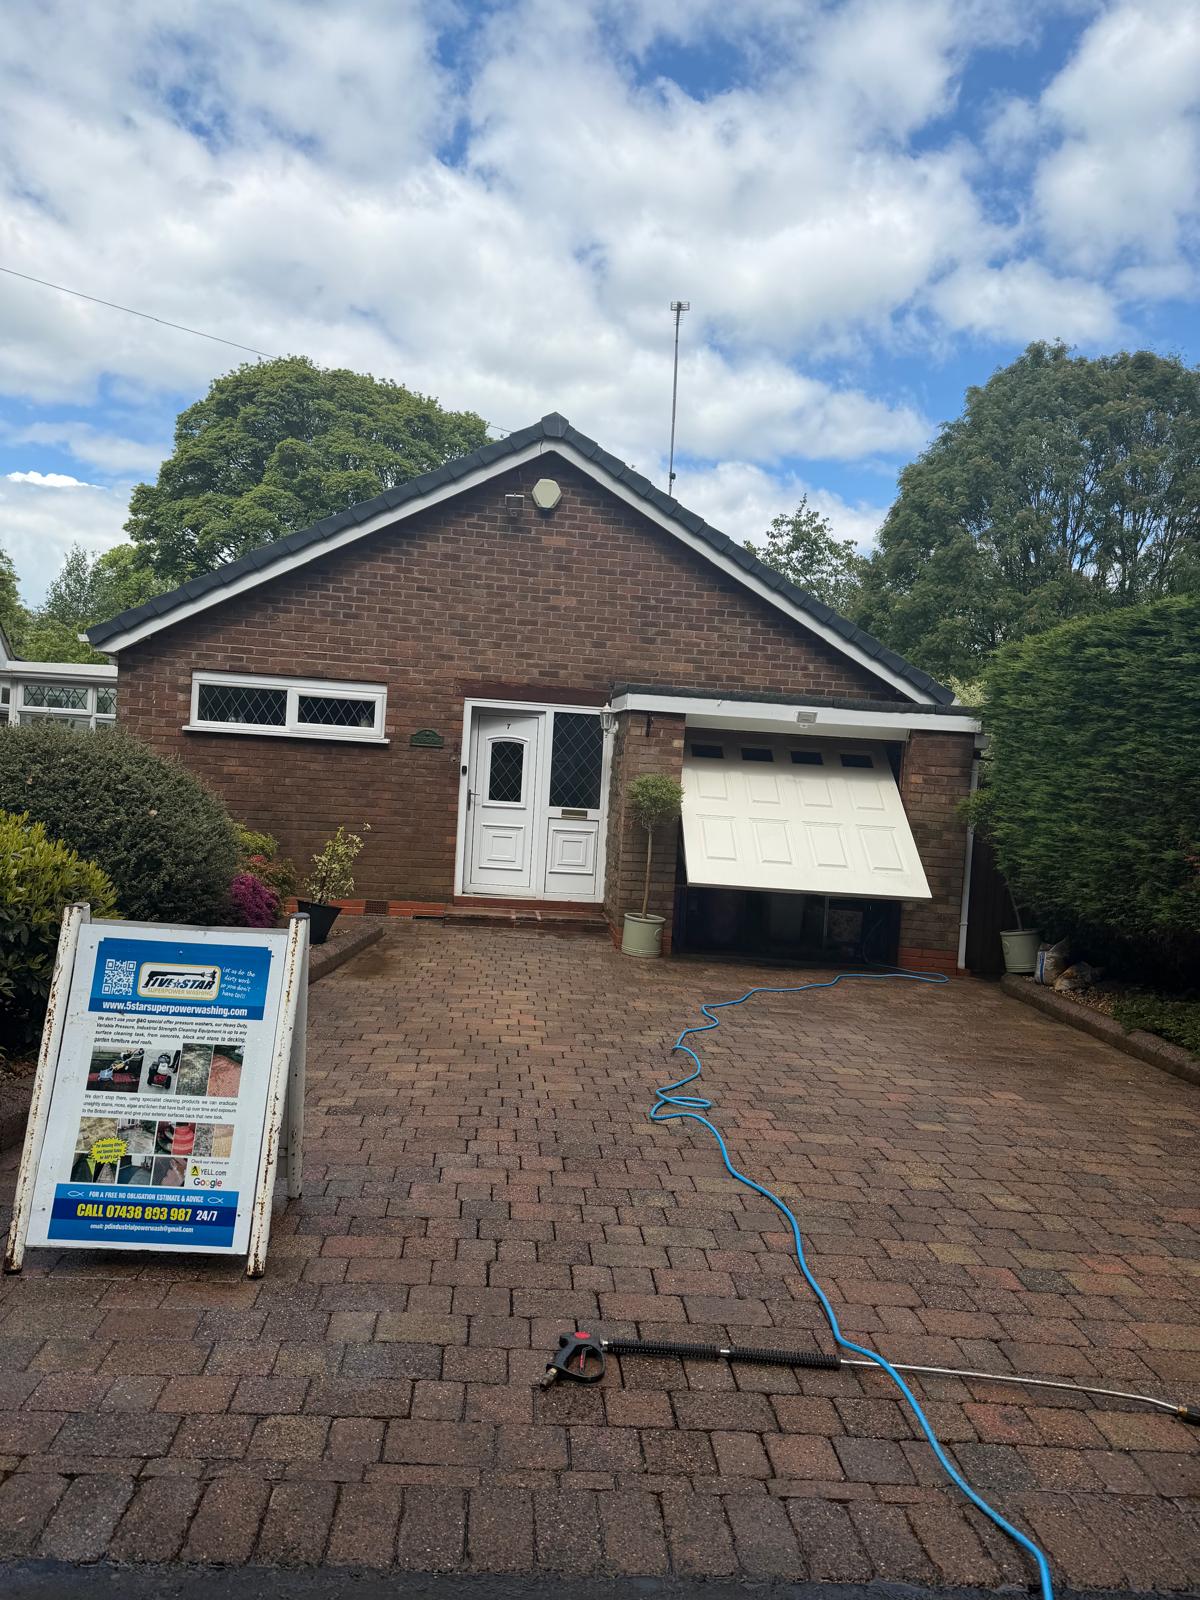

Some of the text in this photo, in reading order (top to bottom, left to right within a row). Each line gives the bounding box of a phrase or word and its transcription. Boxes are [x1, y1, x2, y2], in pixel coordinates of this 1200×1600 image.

[180, 979, 215, 990] STAR
[102, 1001, 248, 1017] www.5starsuperpowerwashing.com
[194, 1178, 222, 1188] Google
[76, 1203, 218, 1222] CALL 07438 893 987 24/7
